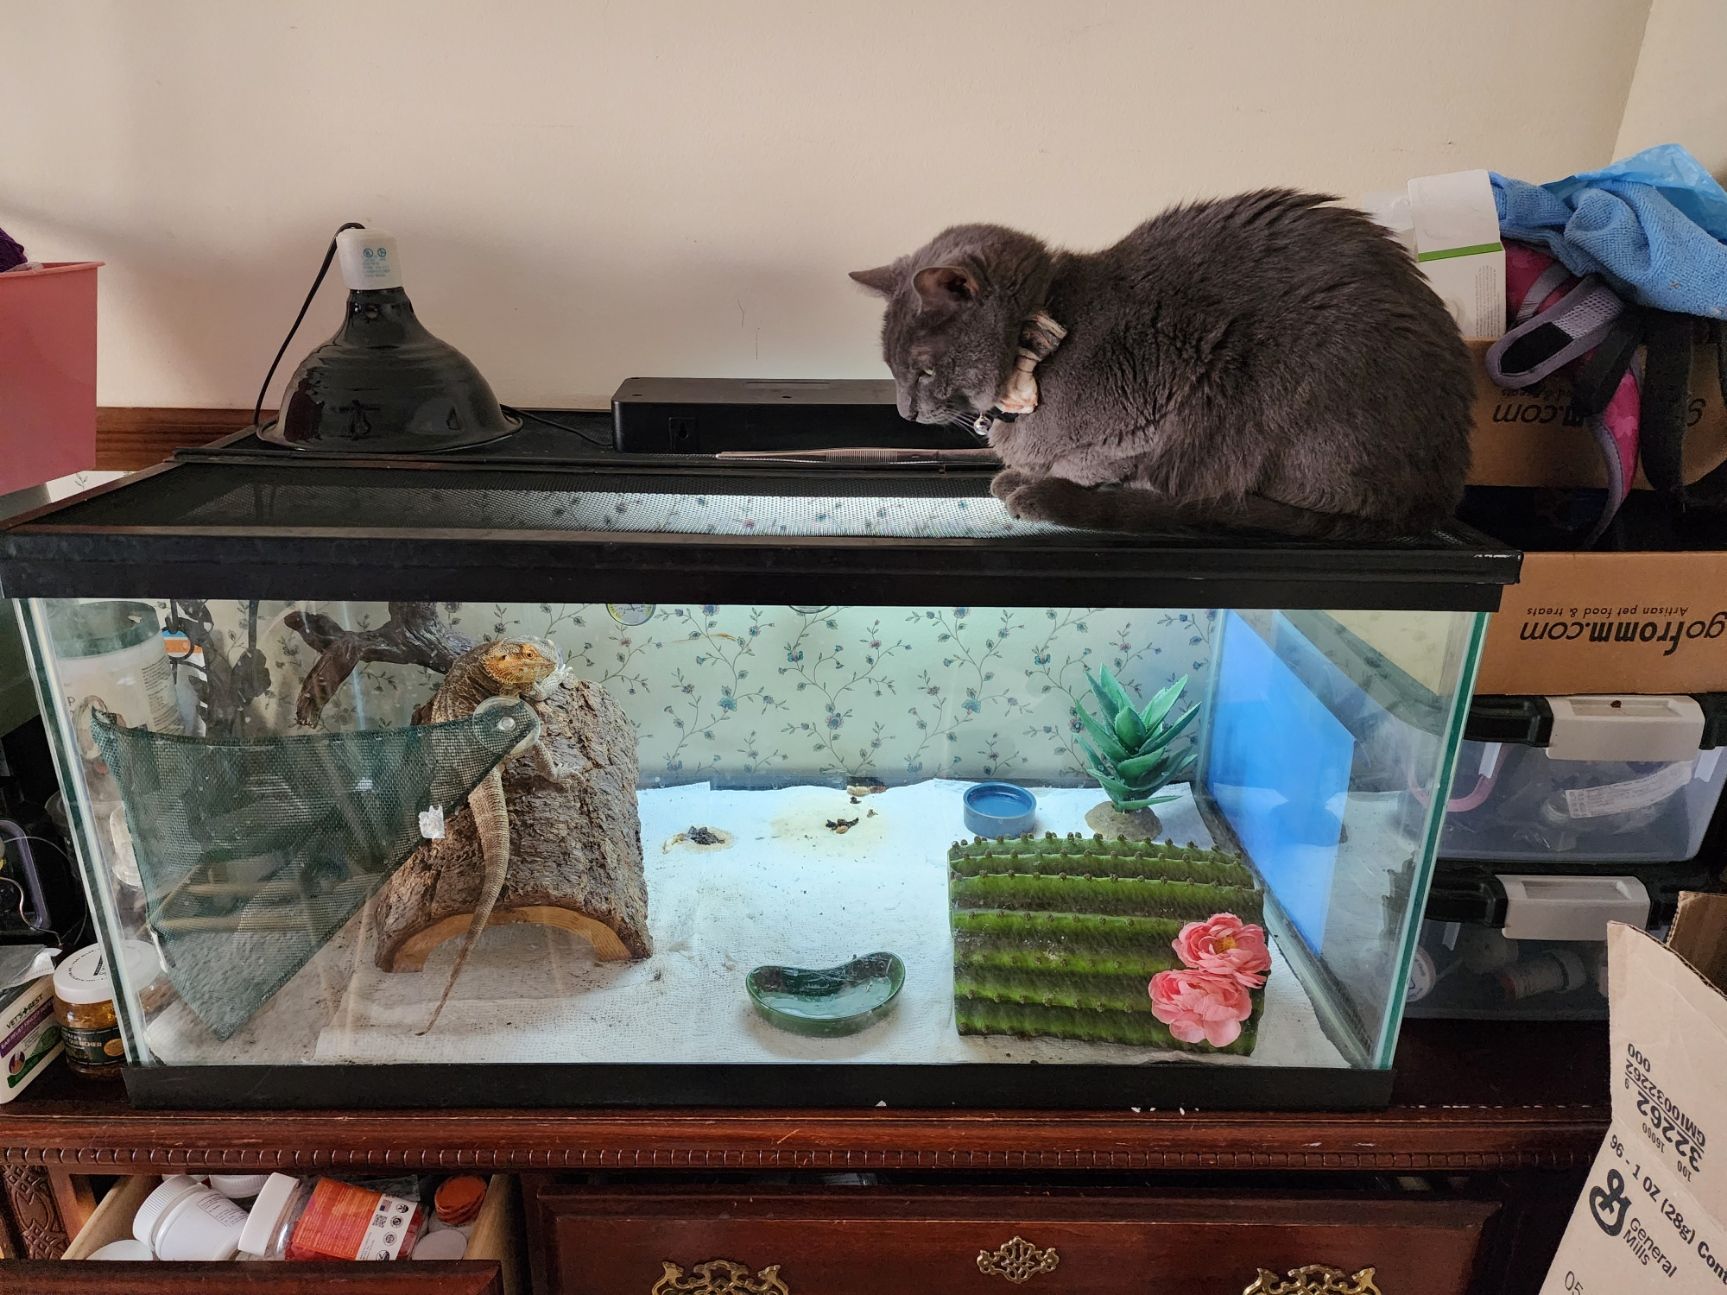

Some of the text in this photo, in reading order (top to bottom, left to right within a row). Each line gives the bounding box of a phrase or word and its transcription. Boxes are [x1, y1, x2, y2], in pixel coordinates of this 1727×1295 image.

[1519, 611, 1727, 656] gofromm.com
[1527, 605, 1689, 620] Artisan pet food & treats
[1636, 1090, 1703, 1173] 32262
[1642, 1122, 1692, 1182] 100 16000
[1610, 1134, 1624, 1158] 96
[1632, 1164, 1641, 1180] 1
[1660, 1198, 1696, 1245] (28g)
[1623, 1229, 1650, 1266] Mills
[1630, 1217, 1678, 1278] General
